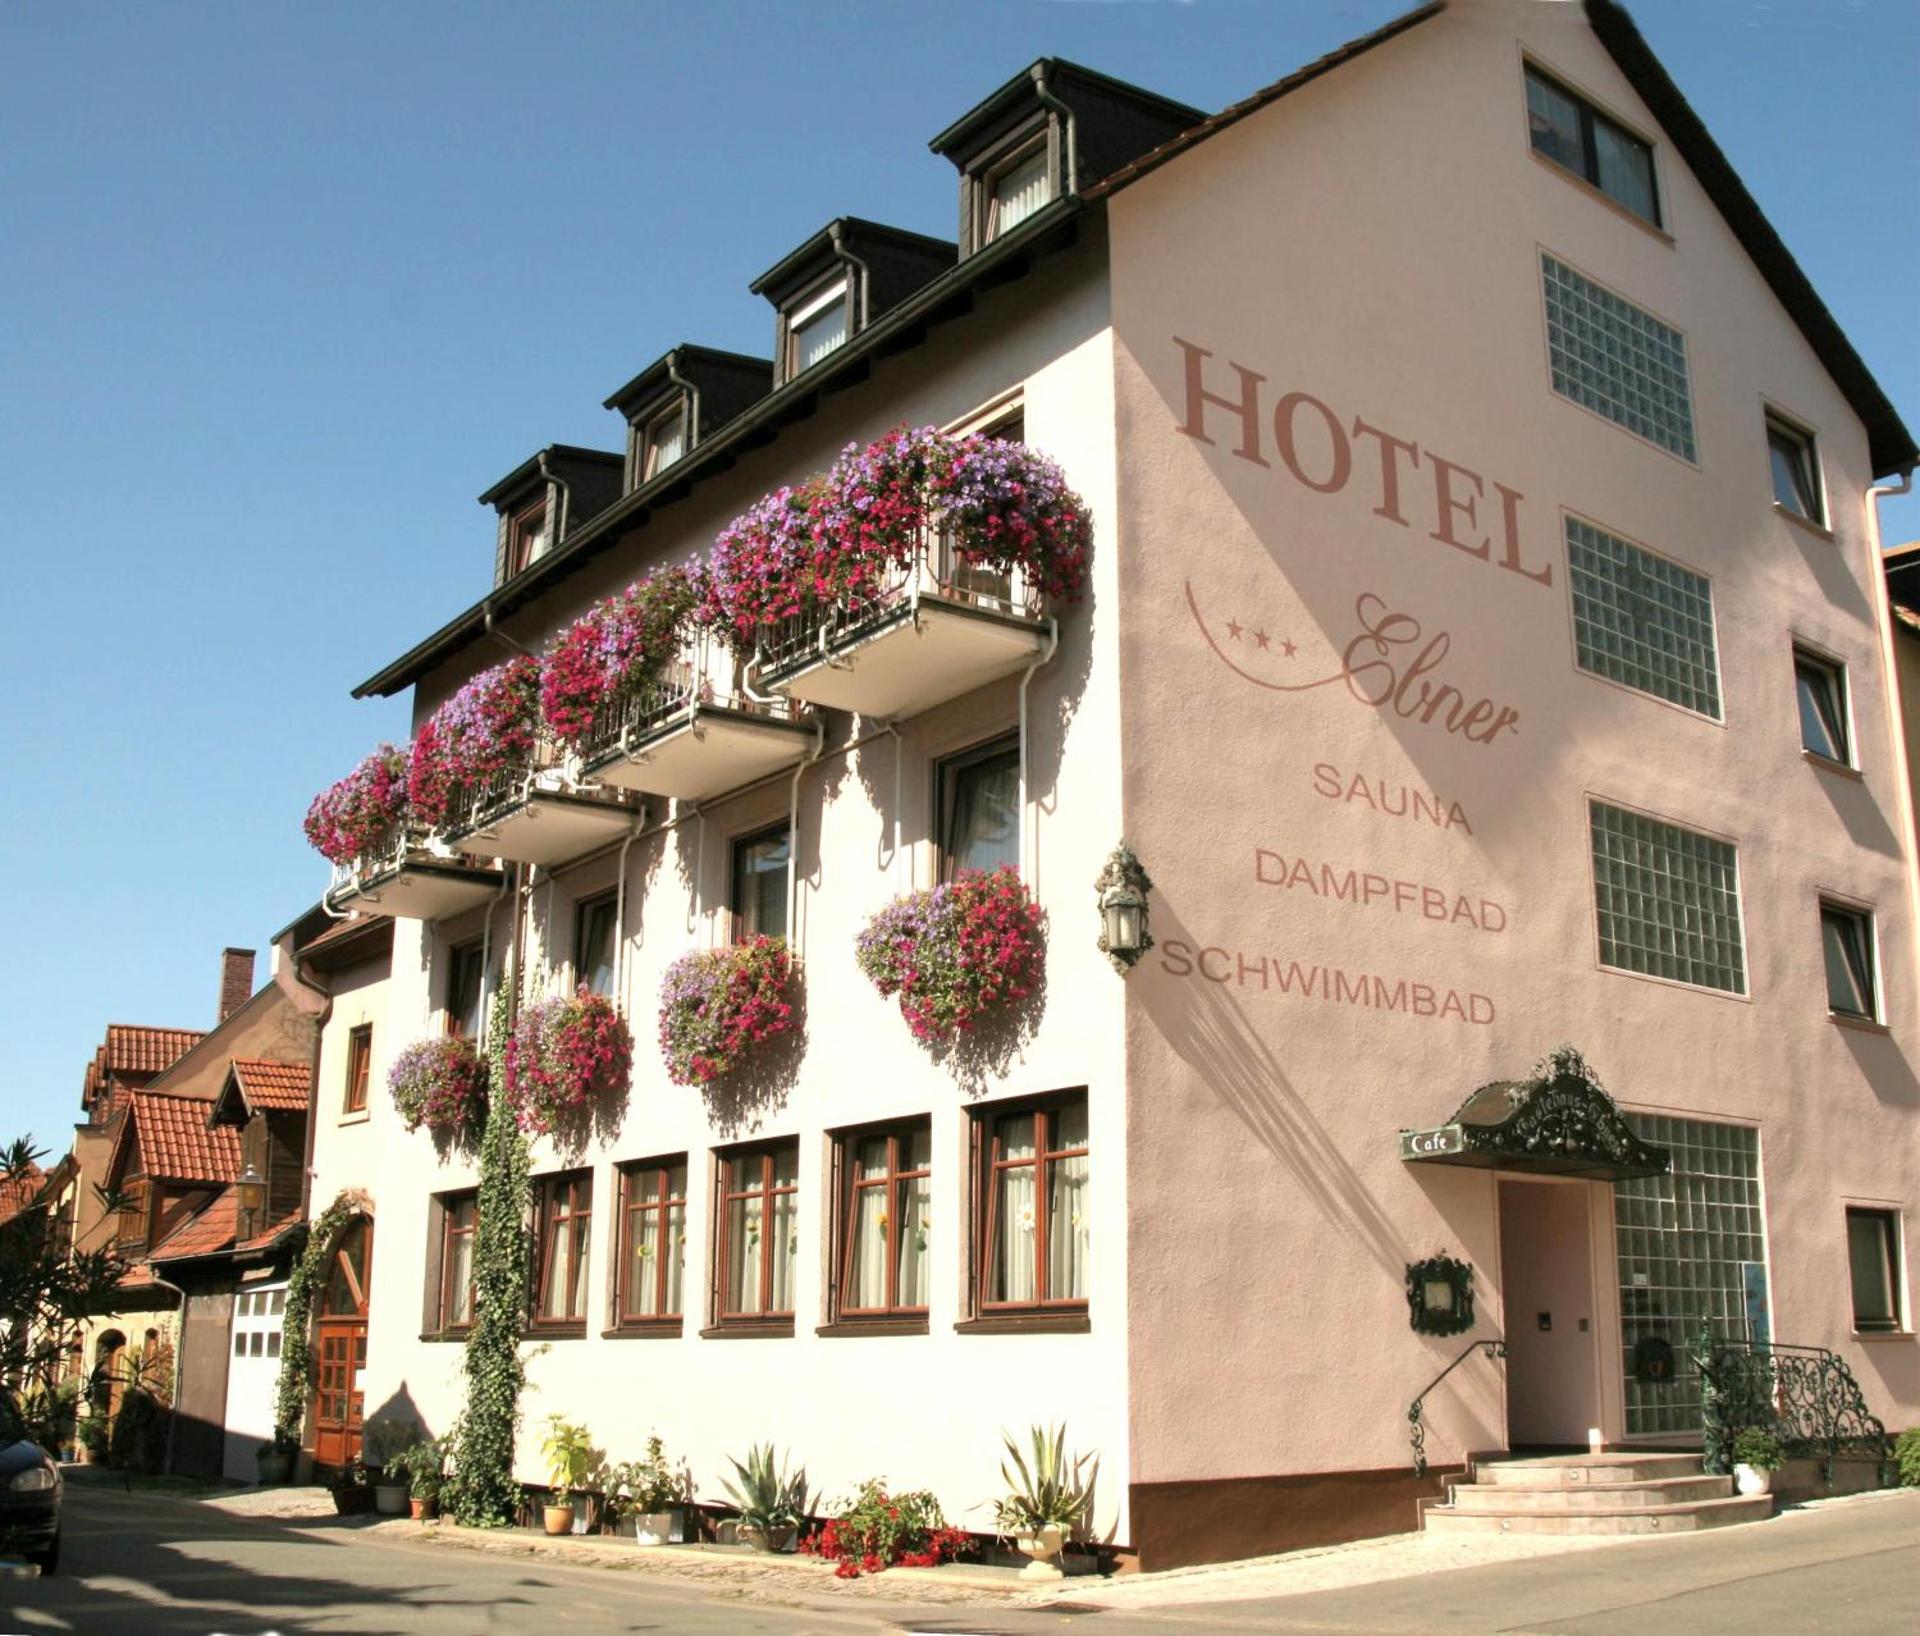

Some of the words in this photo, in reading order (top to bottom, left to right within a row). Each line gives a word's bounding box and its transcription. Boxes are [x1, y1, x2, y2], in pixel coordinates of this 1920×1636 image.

[1173, 335, 1552, 587] HOTEL
[1343, 592, 1519, 745] Ebner
[1313, 763, 1473, 836] SAUNA
[1255, 848, 1507, 933] DAMPFBAD
[1160, 939, 1496, 1025] SCHWIMMBAD
